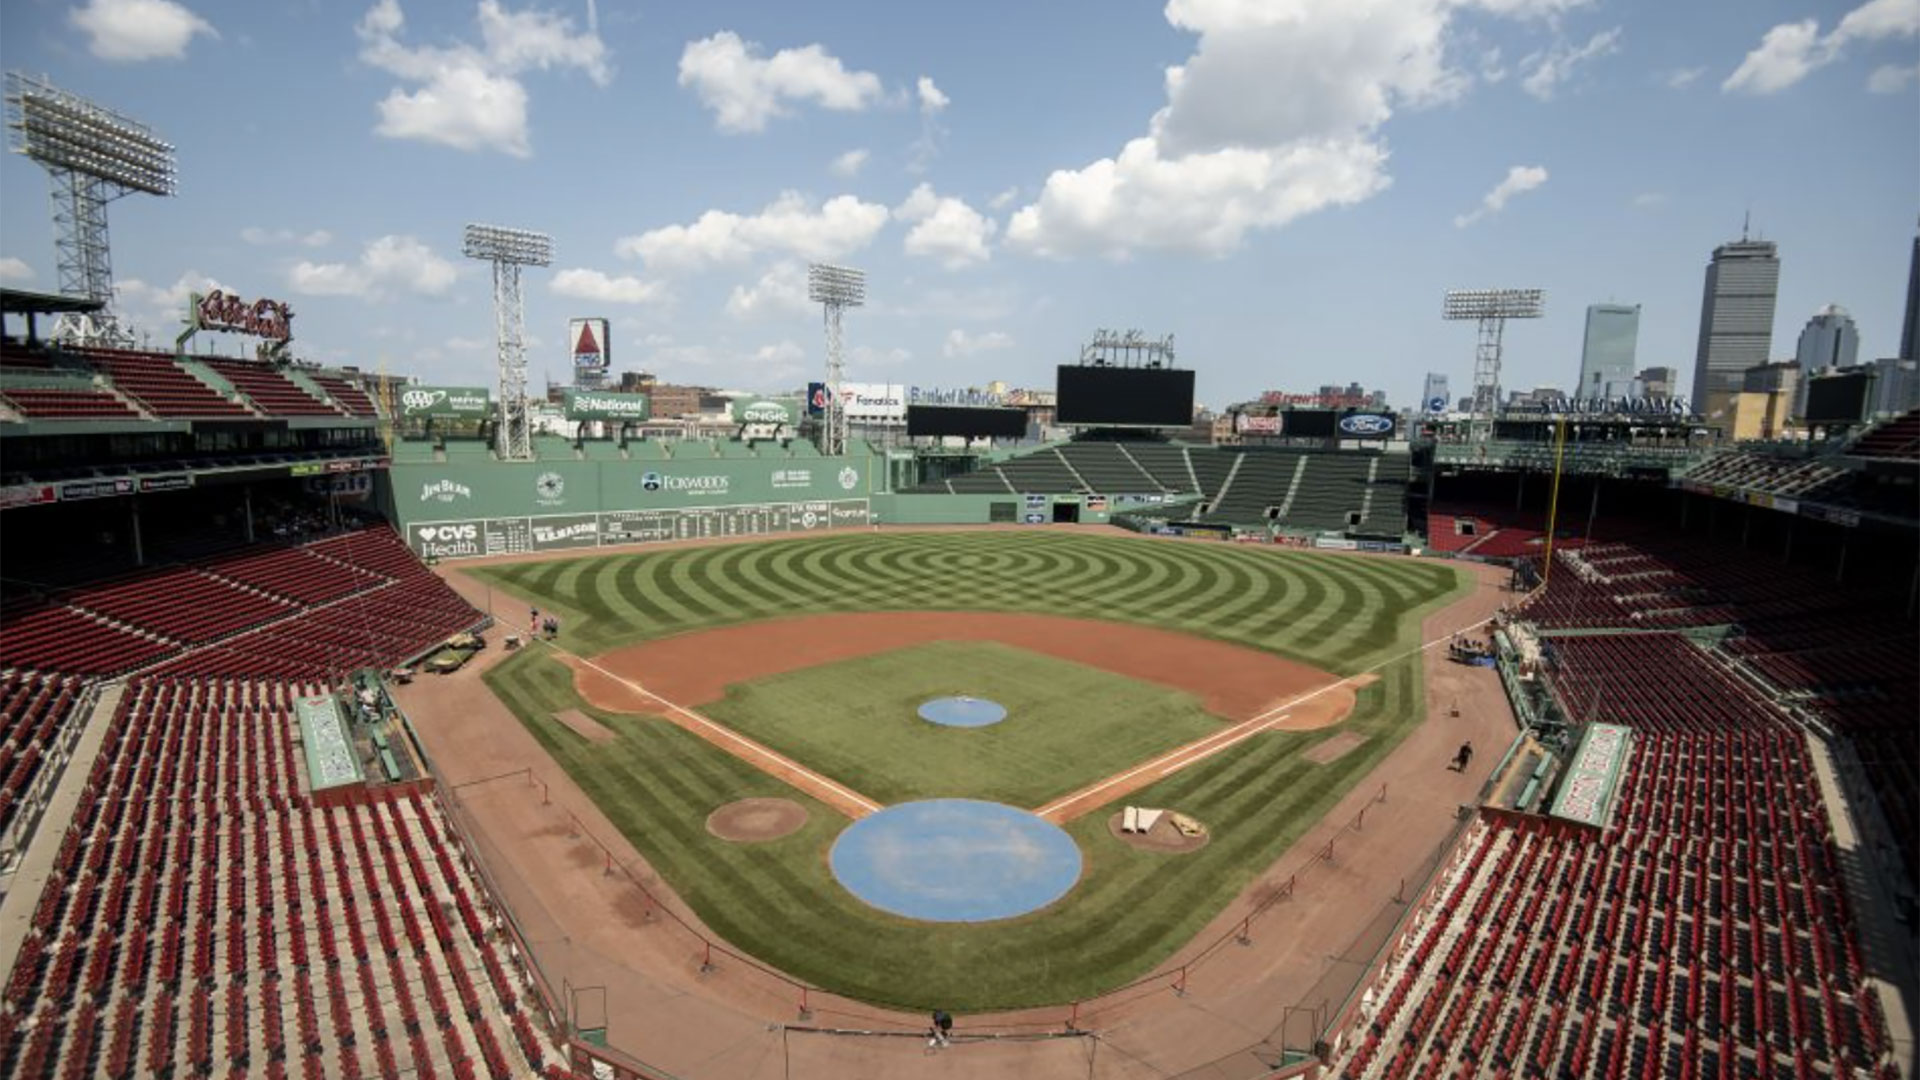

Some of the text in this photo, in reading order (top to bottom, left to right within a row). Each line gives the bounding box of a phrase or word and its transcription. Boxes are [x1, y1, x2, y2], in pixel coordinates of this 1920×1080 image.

[589, 398, 642, 411] National
[856, 394, 899, 406] Fanatics
[438, 524, 477, 540] CVS
[421, 541, 478, 557] Health
